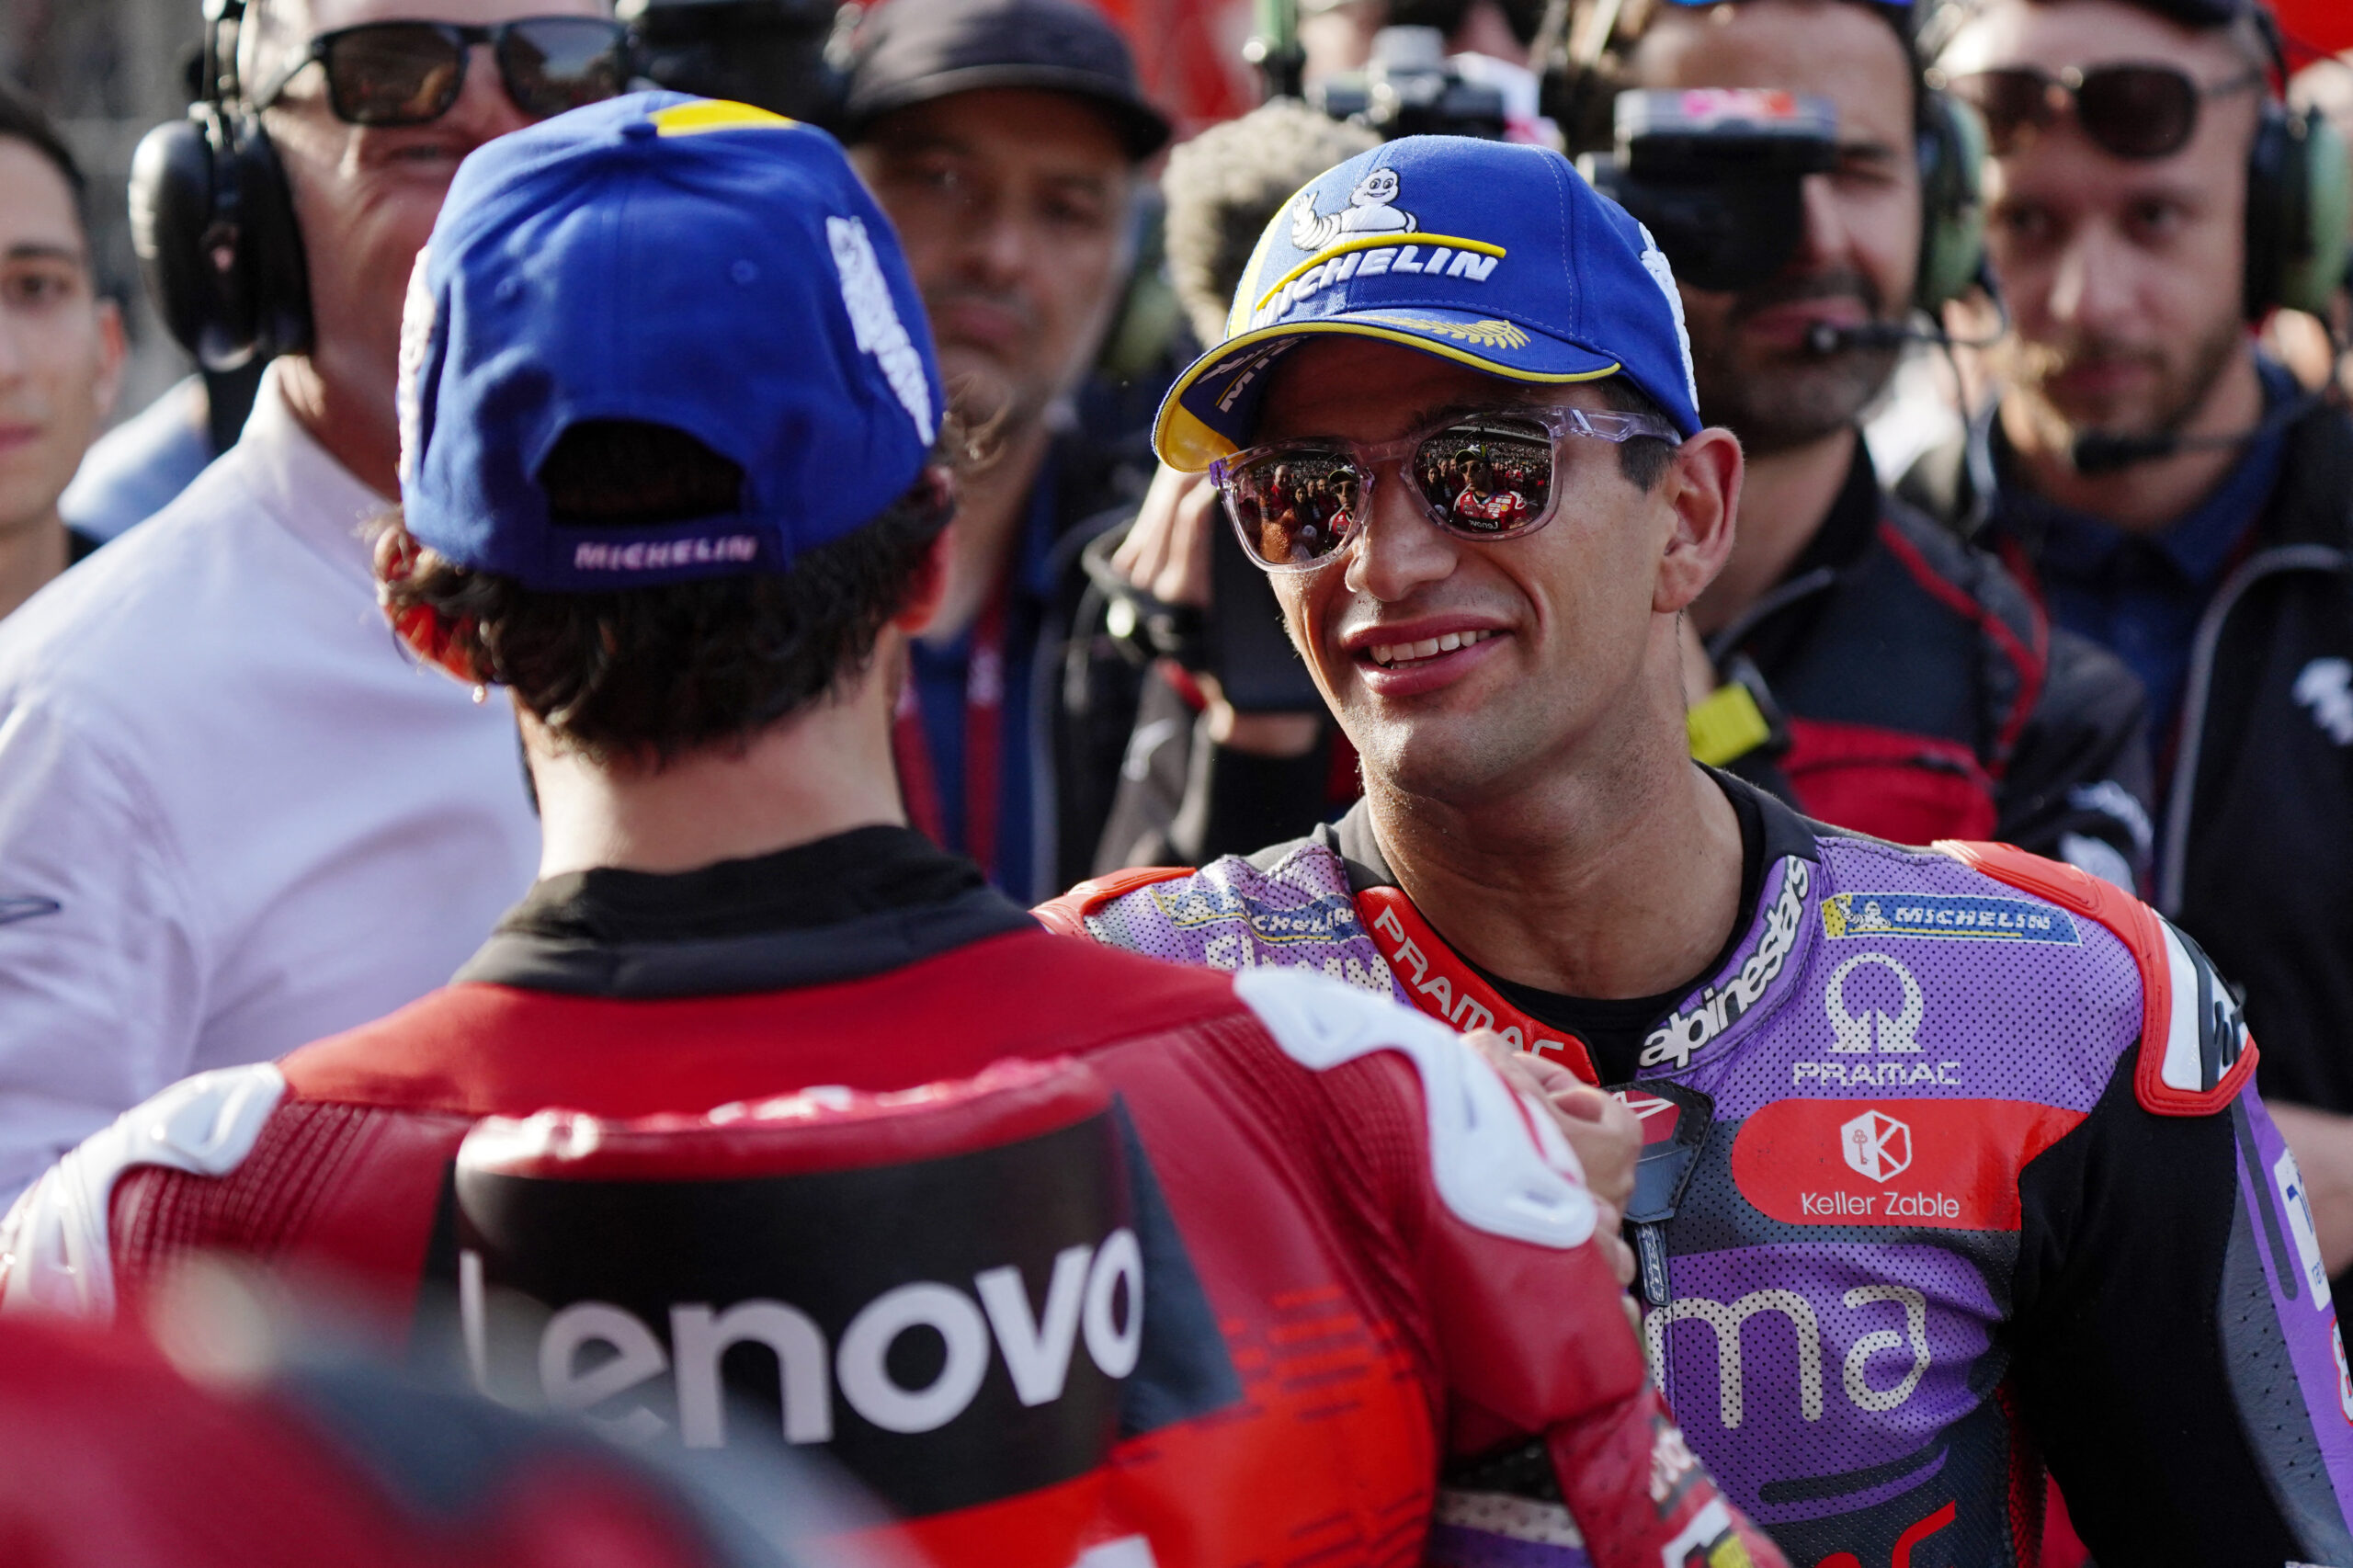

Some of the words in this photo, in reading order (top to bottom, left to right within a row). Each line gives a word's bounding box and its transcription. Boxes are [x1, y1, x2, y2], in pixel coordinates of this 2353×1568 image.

[574, 535, 758, 571] MICHELIN
[1895, 907, 2052, 931] MICHELIN
[1640, 854, 1809, 1069] alpinestars
[1793, 1061, 1961, 1087] PRAMAC
[1802, 1191, 1876, 1216] Keller
[1883, 1191, 1960, 1218] Zable
